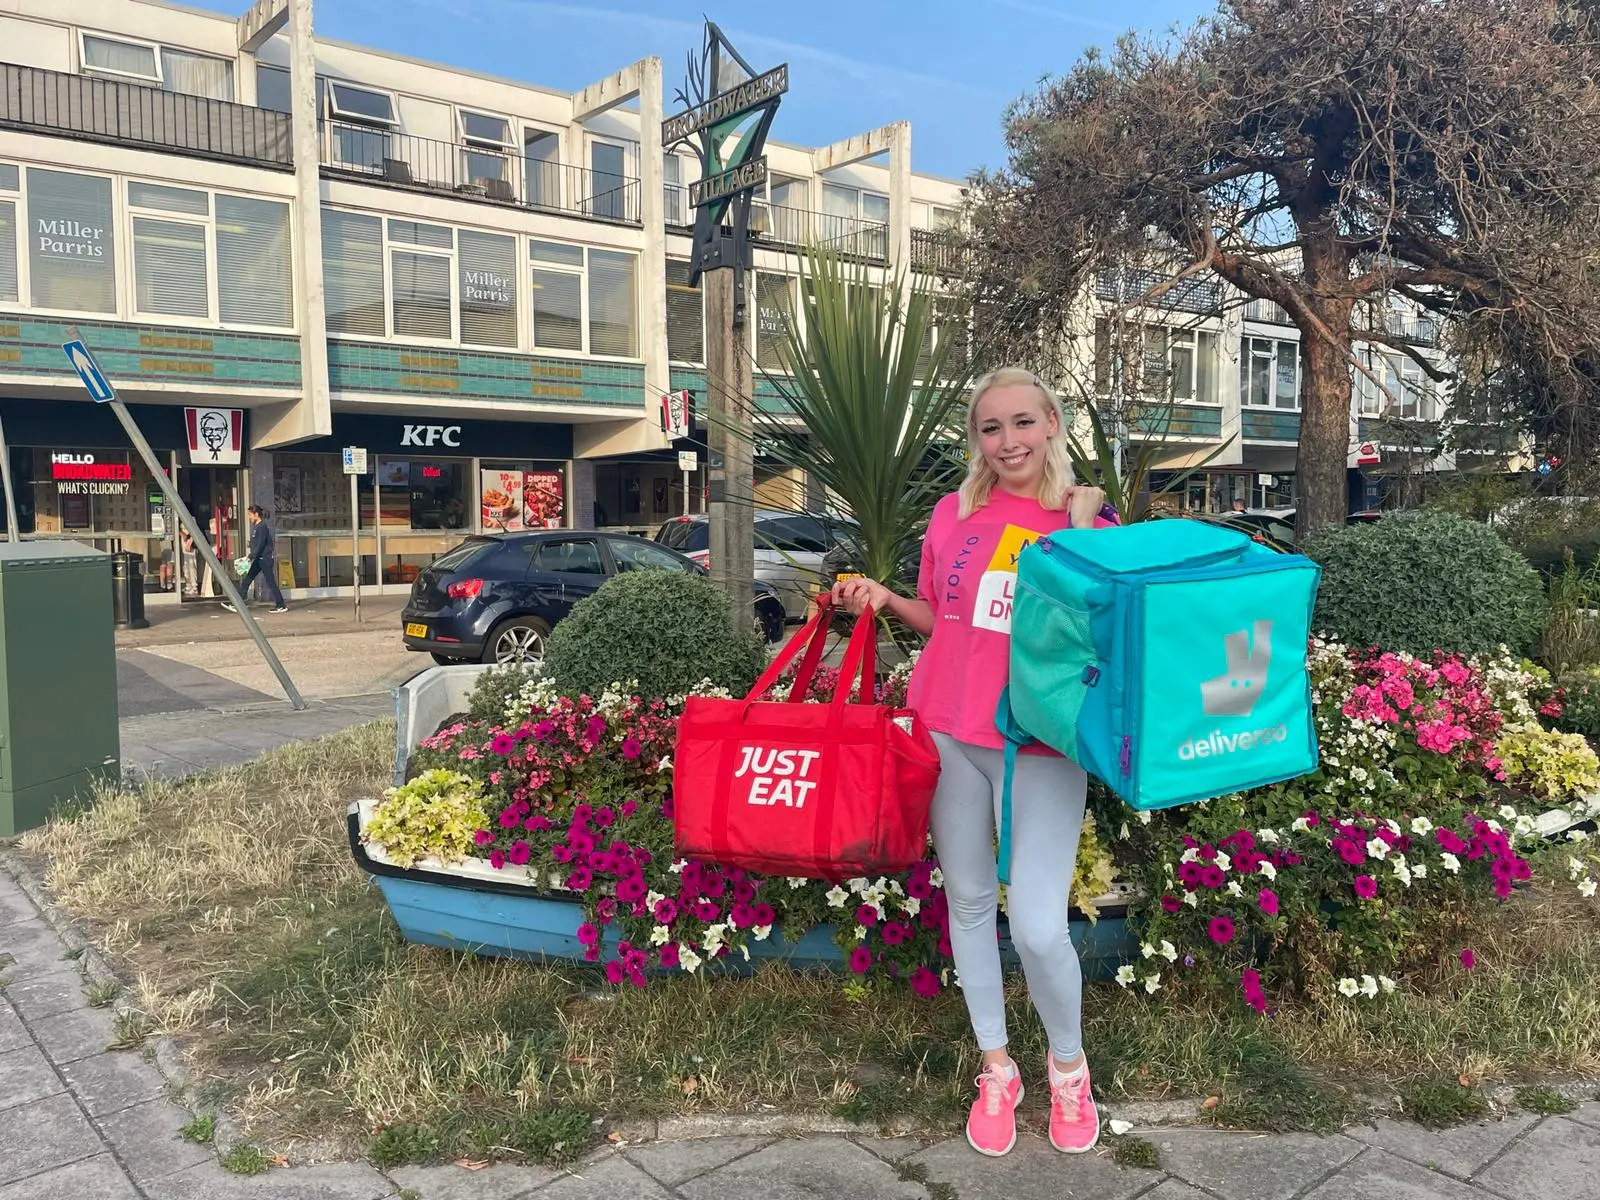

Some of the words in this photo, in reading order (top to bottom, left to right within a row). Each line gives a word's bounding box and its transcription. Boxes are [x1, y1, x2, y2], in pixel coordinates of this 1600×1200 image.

[663, 67, 786, 138] BROADWATER
[690, 159, 766, 202] VILLAGE
[38, 219, 103, 239] Miller
[39, 237, 103, 256] Parris
[465, 271, 509, 287] Miller
[466, 285, 509, 302] Parris
[400, 424, 461, 447] KFC
[51, 453, 94, 464] HELLO
[57, 482, 88, 495] WHAT'S
[89, 482, 129, 495] CLUCKIN'?
[527, 475, 558, 483] DIPPED
[946, 536, 980, 603] TOKYO
[1178, 723, 1287, 760] deliveroo
[735, 746, 820, 778] JUST
[748, 777, 817, 808] EAT
